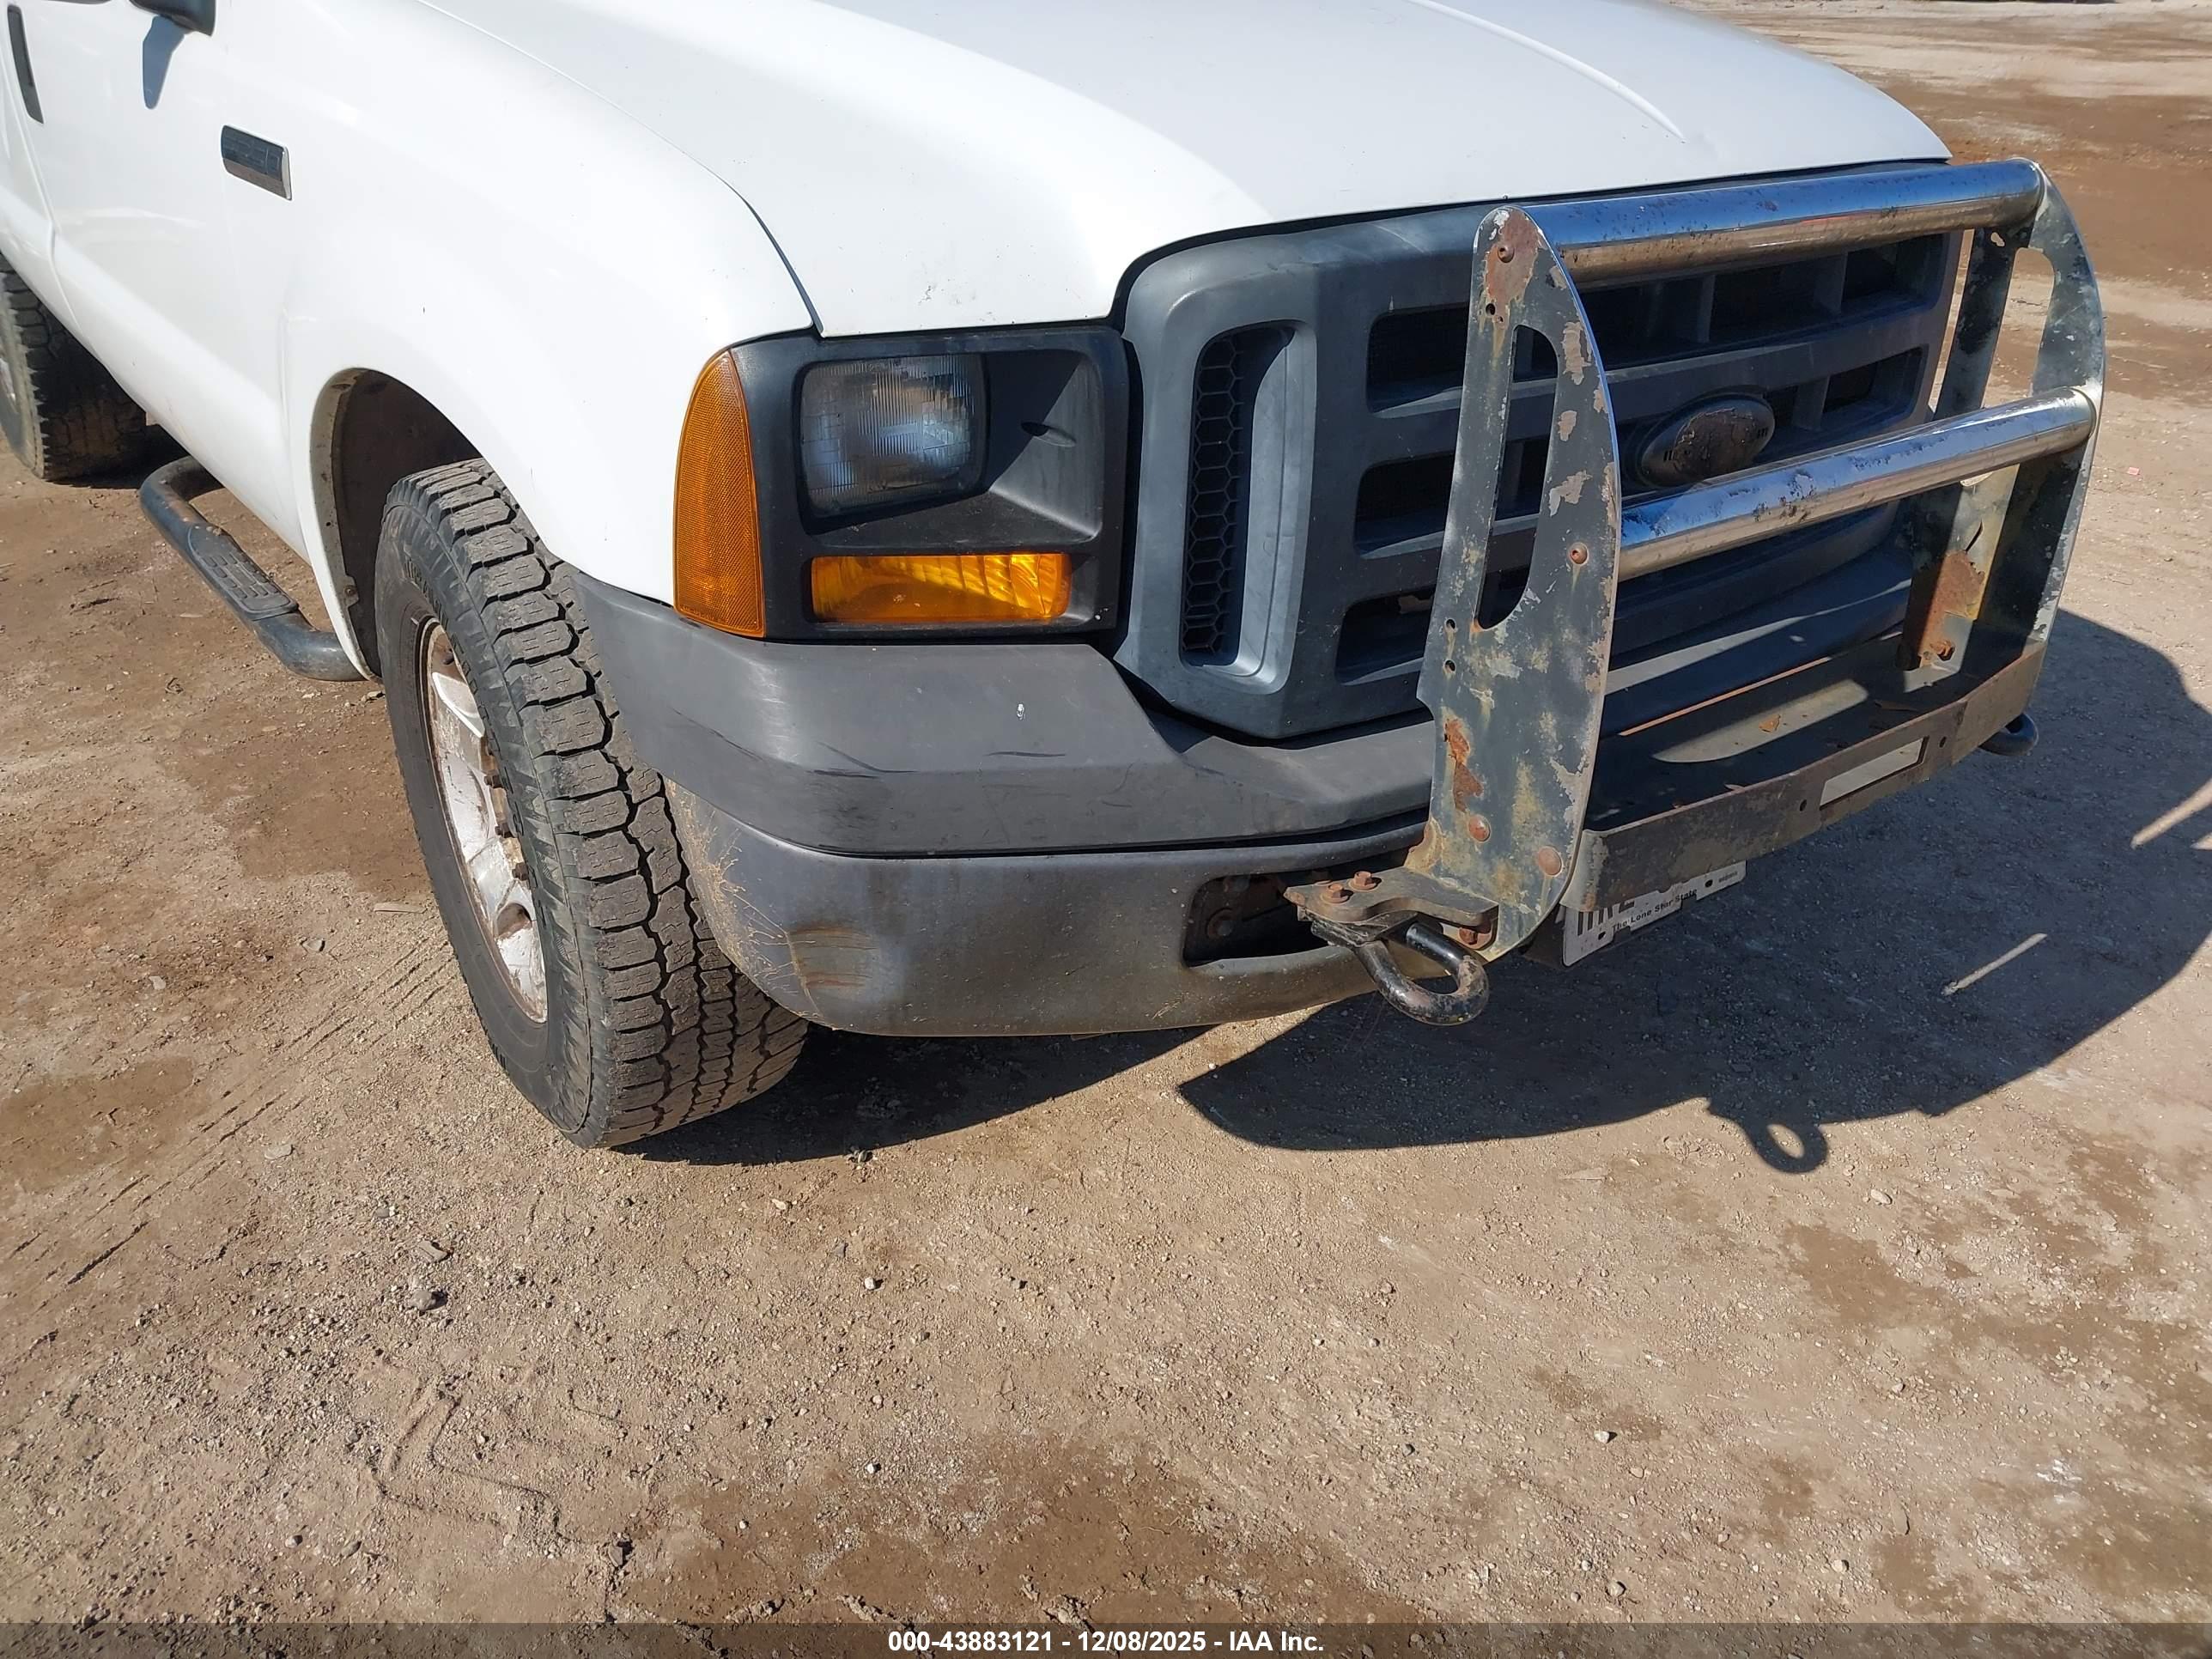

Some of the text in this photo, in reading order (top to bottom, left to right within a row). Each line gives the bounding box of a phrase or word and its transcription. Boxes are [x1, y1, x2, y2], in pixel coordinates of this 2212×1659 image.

[1612, 889, 1698, 932] The Lone Star State
